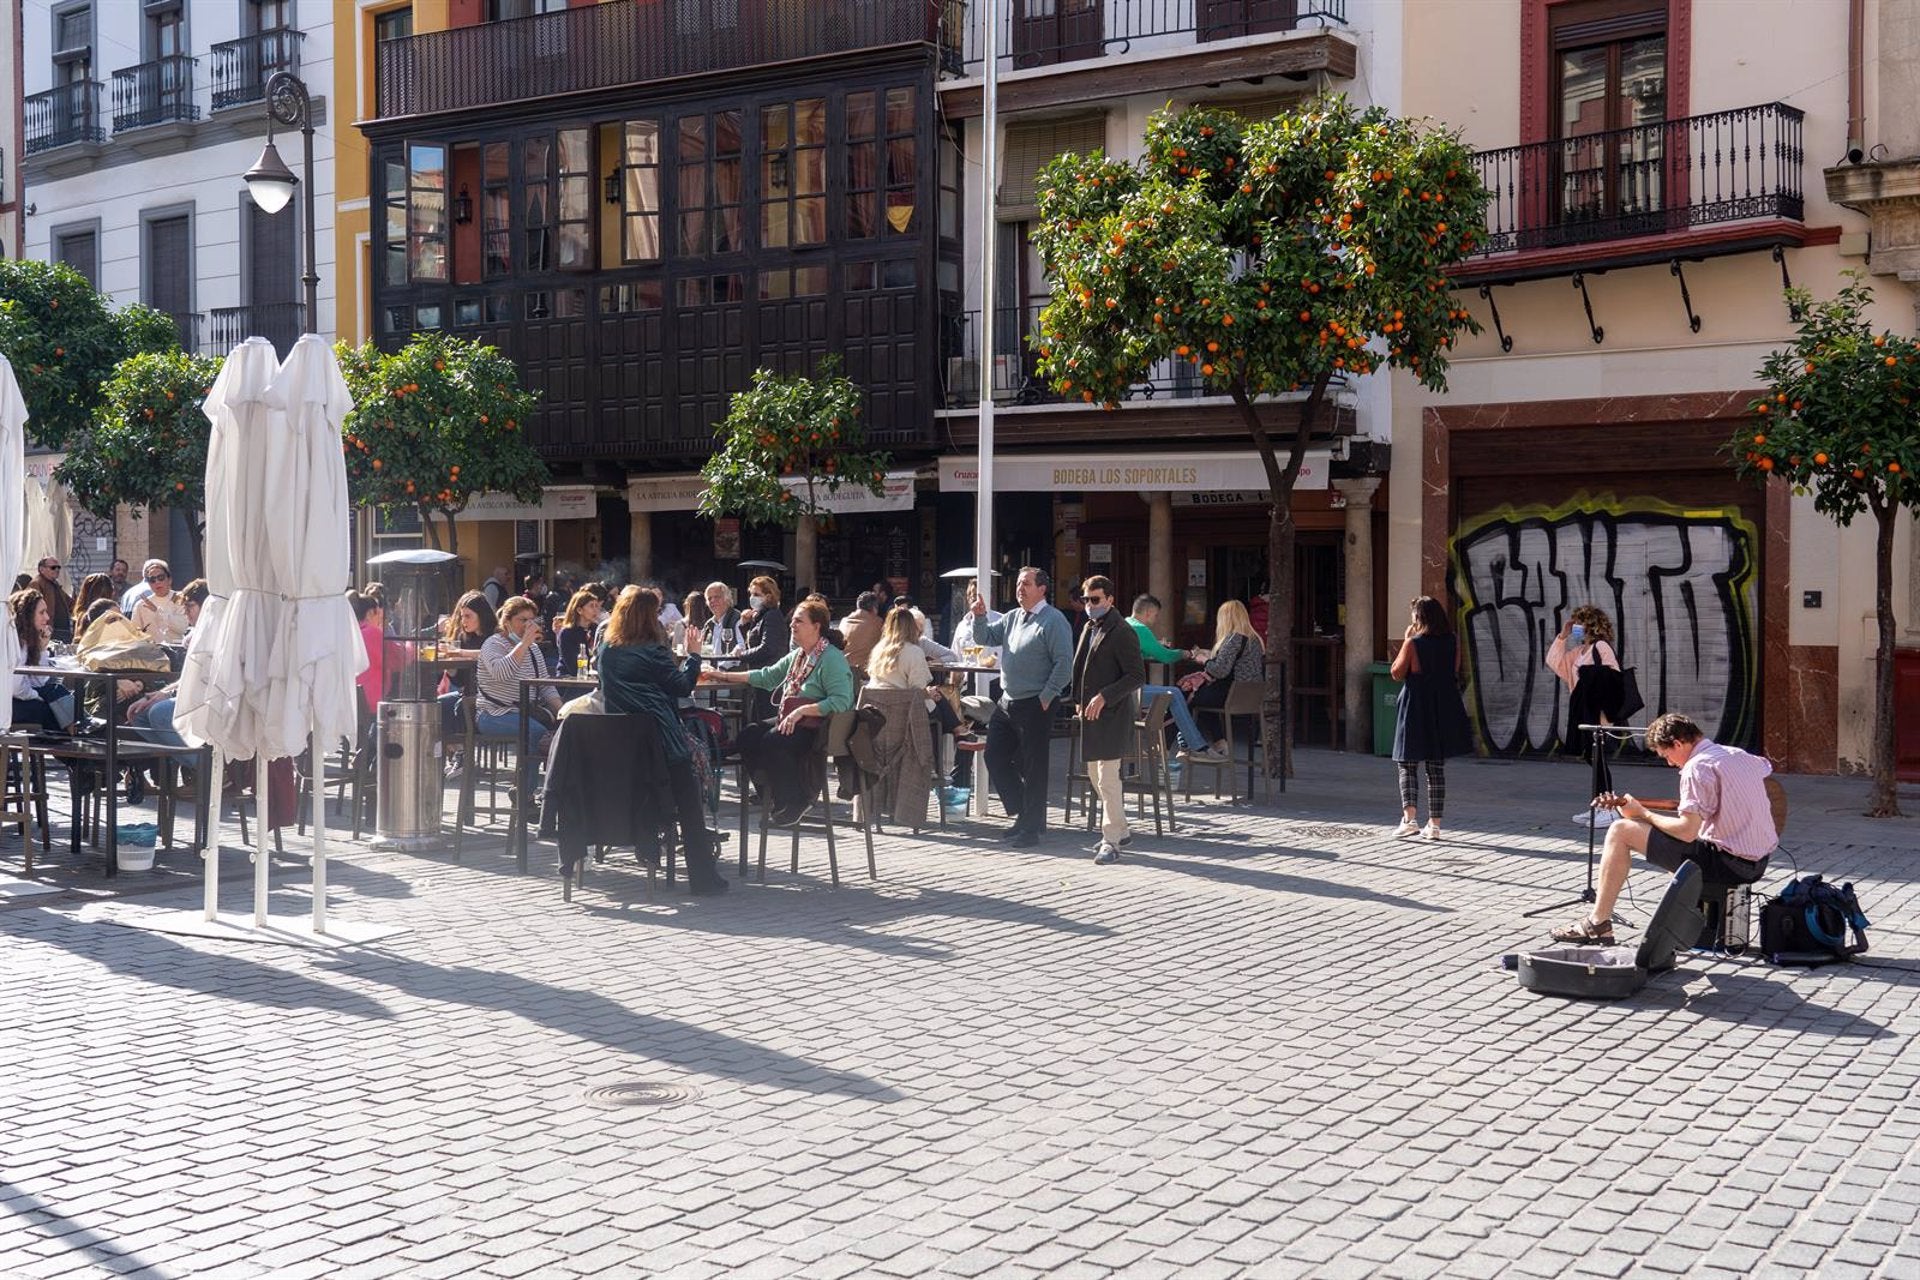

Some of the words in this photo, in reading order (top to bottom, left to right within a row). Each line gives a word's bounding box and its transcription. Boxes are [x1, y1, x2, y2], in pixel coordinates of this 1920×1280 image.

[954, 470, 979, 480] Cruzca
[1053, 468, 1097, 484] BODEGA
[1100, 468, 1121, 484] LOS
[1124, 467, 1197, 484] SOPORTALES
[1192, 493, 1244, 504] BODEGA
